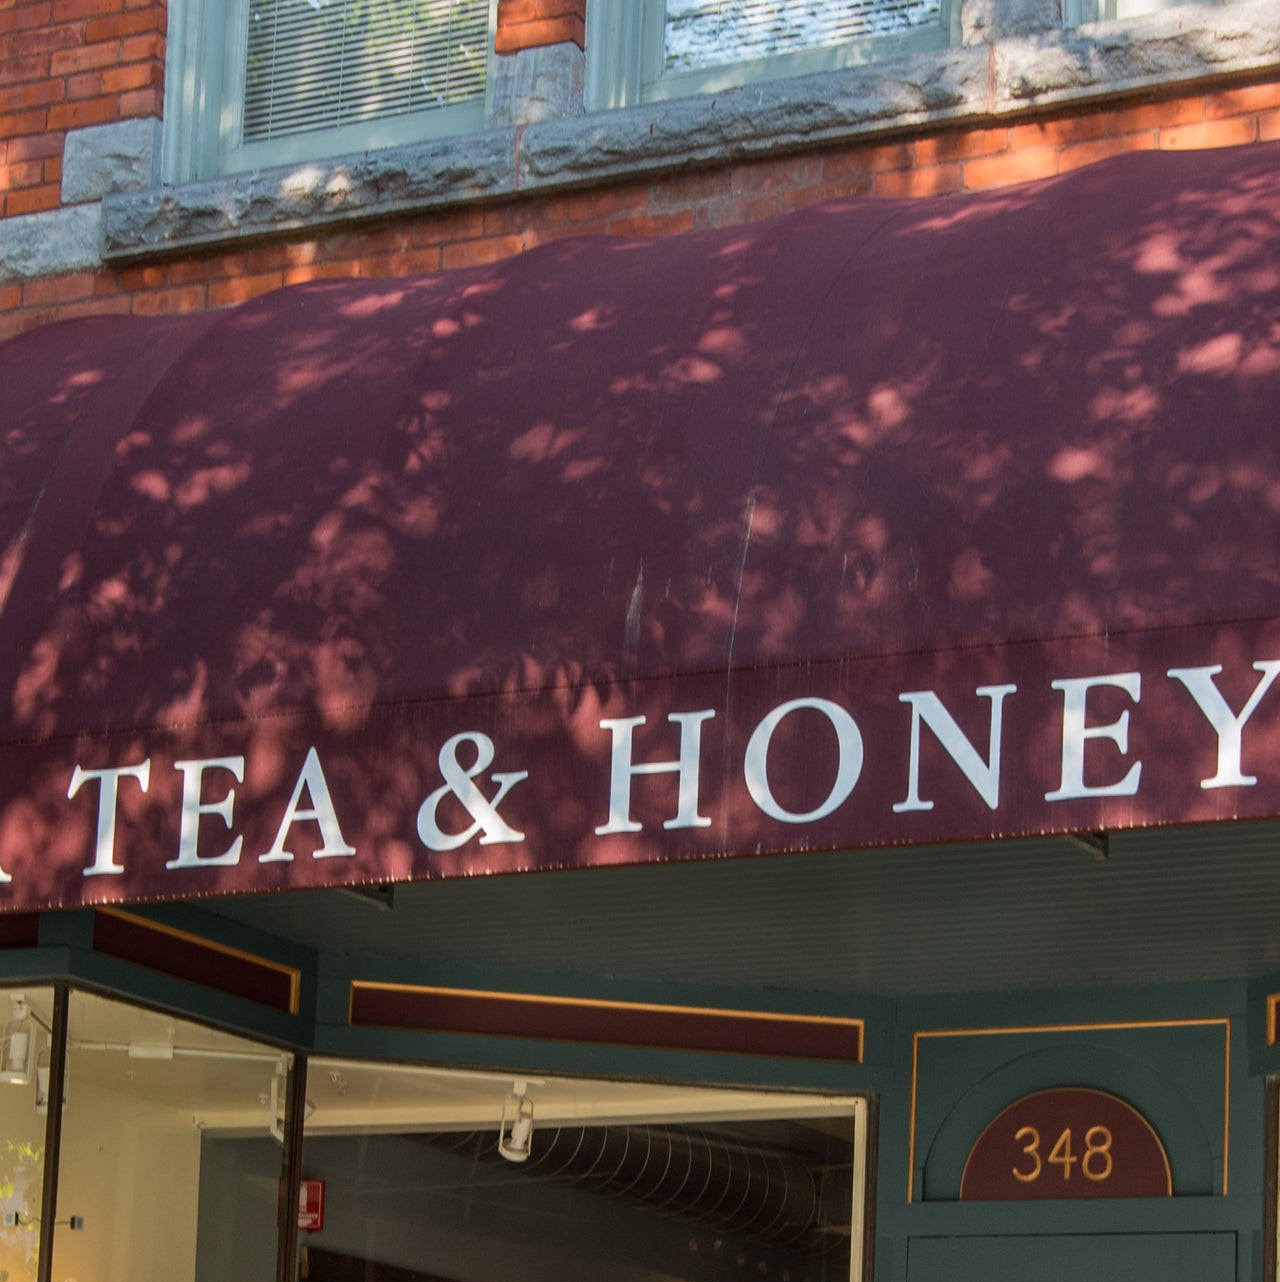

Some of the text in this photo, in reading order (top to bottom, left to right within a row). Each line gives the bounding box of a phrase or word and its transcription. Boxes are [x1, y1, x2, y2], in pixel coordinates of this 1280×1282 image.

[66, 746, 357, 877] TEA
[416, 730, 529, 851] &
[1011, 1125, 1114, 1182] 348
